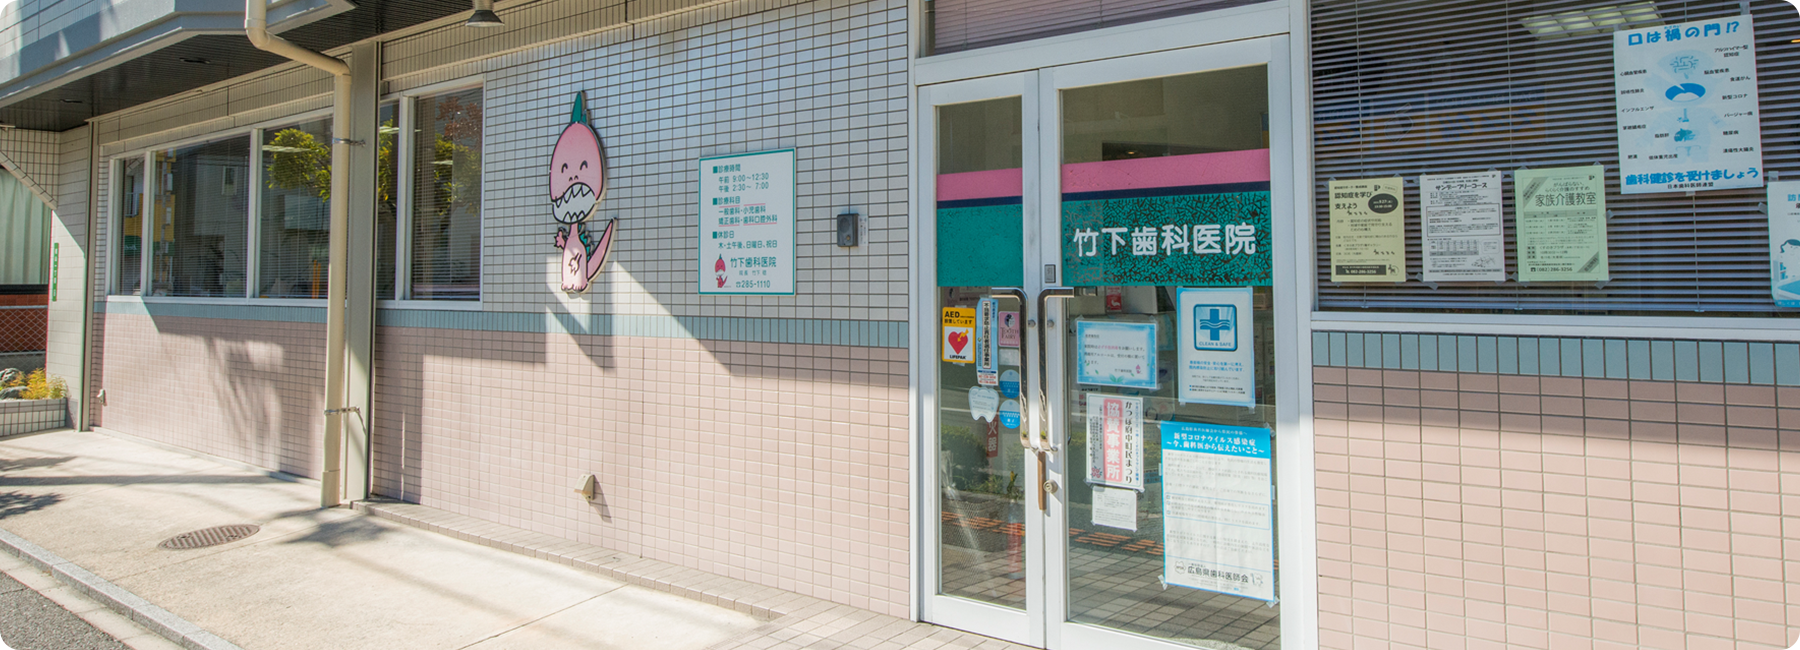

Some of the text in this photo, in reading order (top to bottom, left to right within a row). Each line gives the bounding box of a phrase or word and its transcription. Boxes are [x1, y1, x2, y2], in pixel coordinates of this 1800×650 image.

[1621, 105, 1655, 113] インフルエンザ
[718, 164, 741, 173] 診療時間
[718, 176, 730, 184] 午前
[1626, 167, 1759, 186] 歯科健診を受けましょう
[718, 184, 730, 192] 午後
[1334, 191, 1373, 199] 認知症を学び
[718, 196, 741, 205] 診療科目
[1535, 192, 1597, 208] 家族介護教室
[1334, 202, 1358, 210] 支えよう
[718, 230, 734, 239] 休診日
[1073, 222, 1256, 258] 竹下歯科医院
[730, 256, 777, 268] 竹下歯科医院
[741, 280, 771, 288] 285-1110
[1000, 327, 1020, 338] TOOTH
[1107, 402, 1120, 480] 協賛事業所
[1174, 432, 1256, 447] 新型コロナウイルス感染症
[1188, 566, 1249, 584] 広島県歯科医師会
